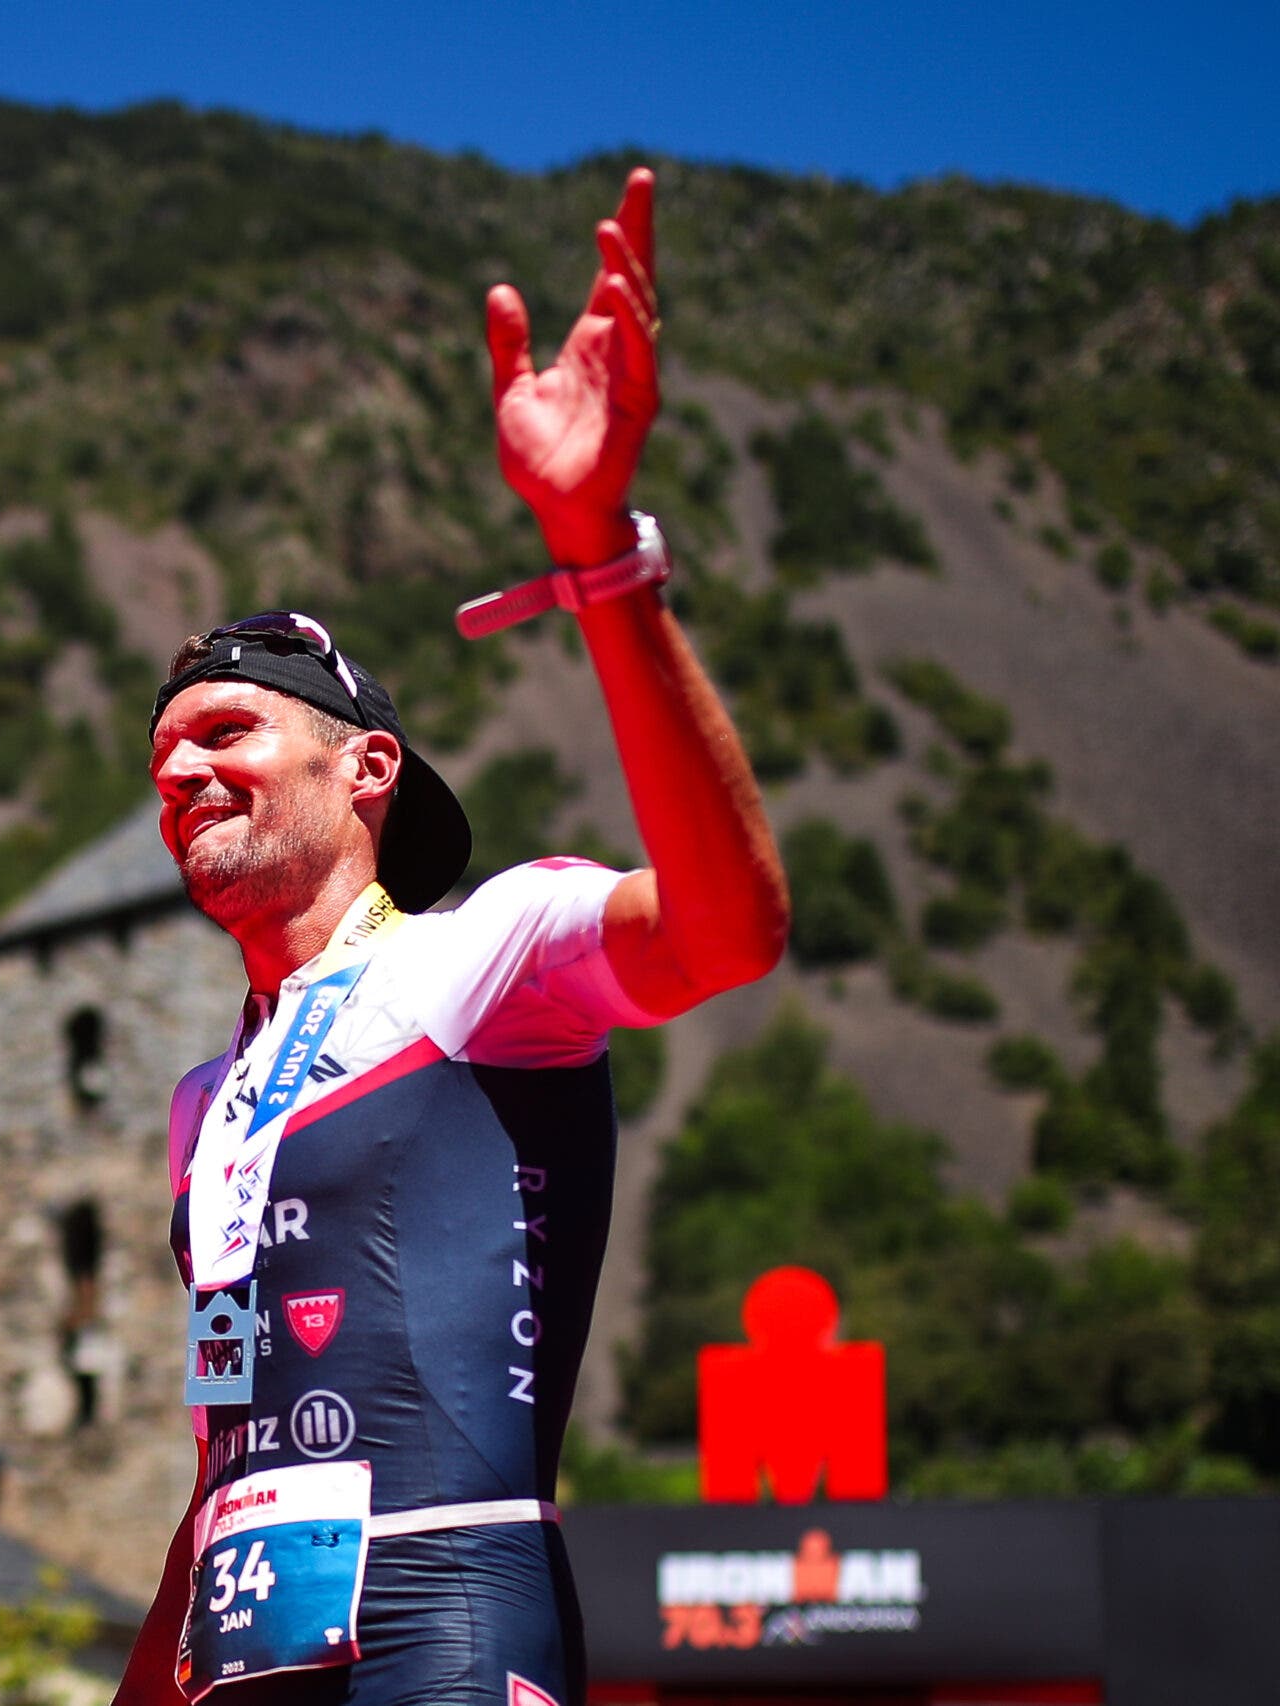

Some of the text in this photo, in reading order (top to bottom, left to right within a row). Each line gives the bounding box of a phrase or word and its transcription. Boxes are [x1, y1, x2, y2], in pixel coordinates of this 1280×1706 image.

[268, 985, 342, 1105] 2 JULY 2023
[302, 1313, 326, 1329] 13
[507, 1164, 547, 1405] RYZON
[209, 1540, 276, 1613] 34
[658, 1528, 920, 1605] IRONMAN
[219, 1608, 253, 1633] JAN
[221, 1660, 246, 1675] 2023
